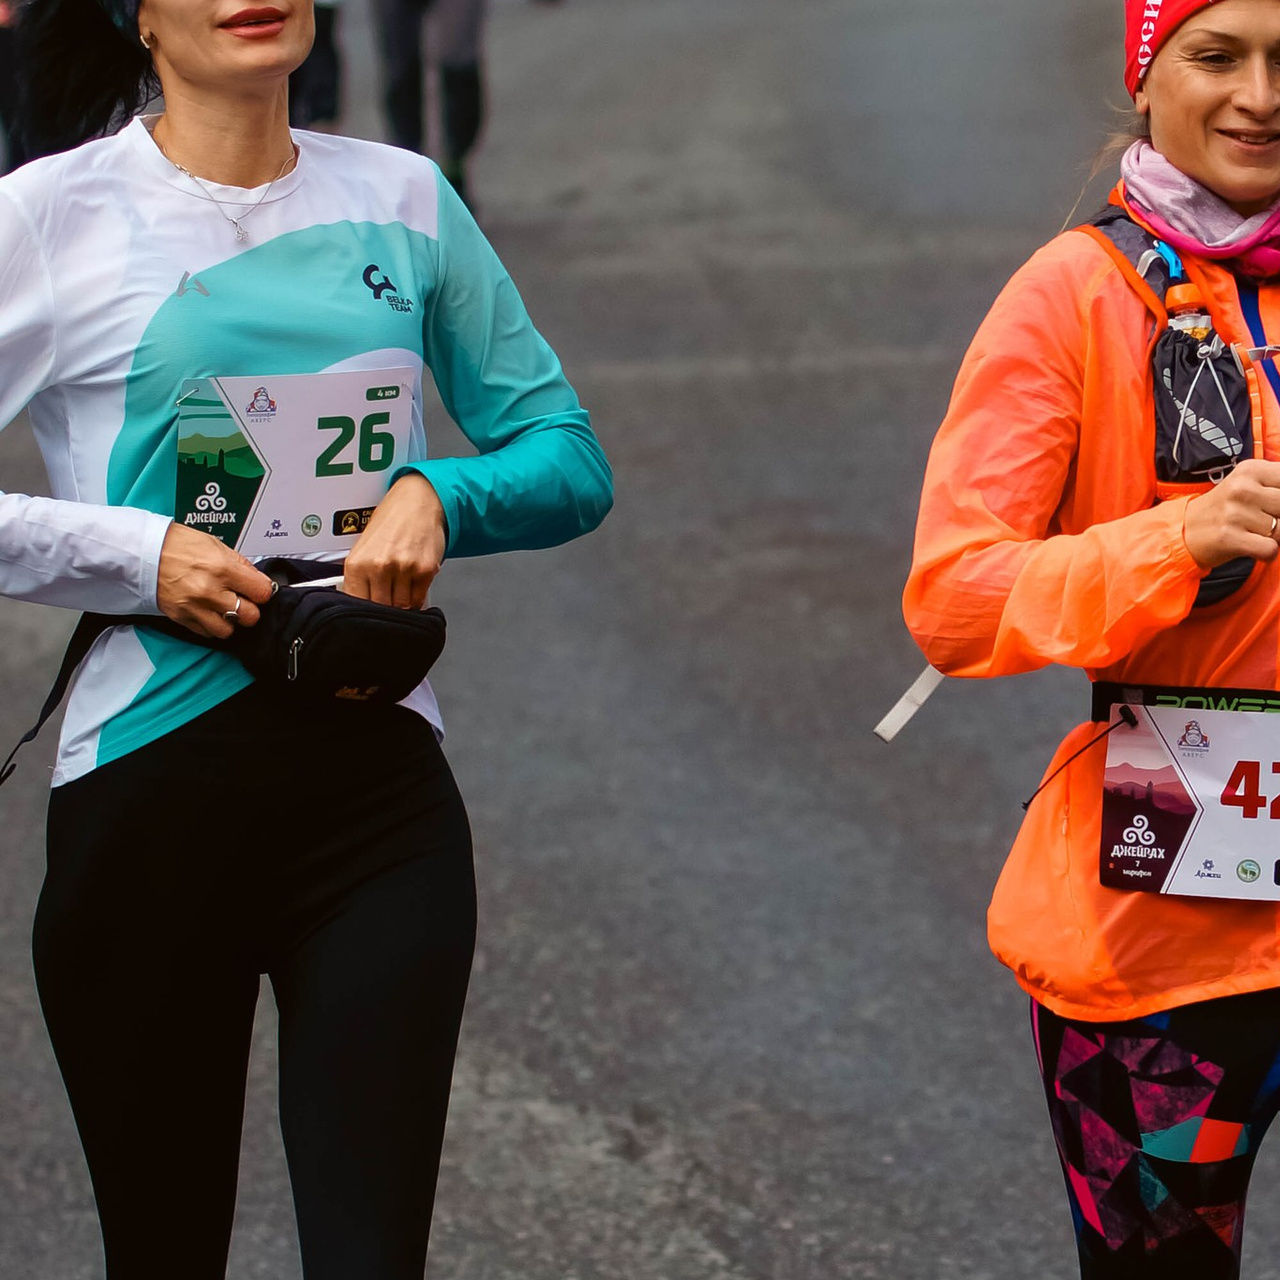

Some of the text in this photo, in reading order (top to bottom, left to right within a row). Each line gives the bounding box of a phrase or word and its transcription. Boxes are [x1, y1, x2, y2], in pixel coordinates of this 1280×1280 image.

[389, 303, 413, 314] TEAM
[315, 412, 395, 478] 26
[184, 511, 237, 525] ДЖЕЙРАХ
[1110, 845, 1166, 859] ДЖЕЙРАХ
